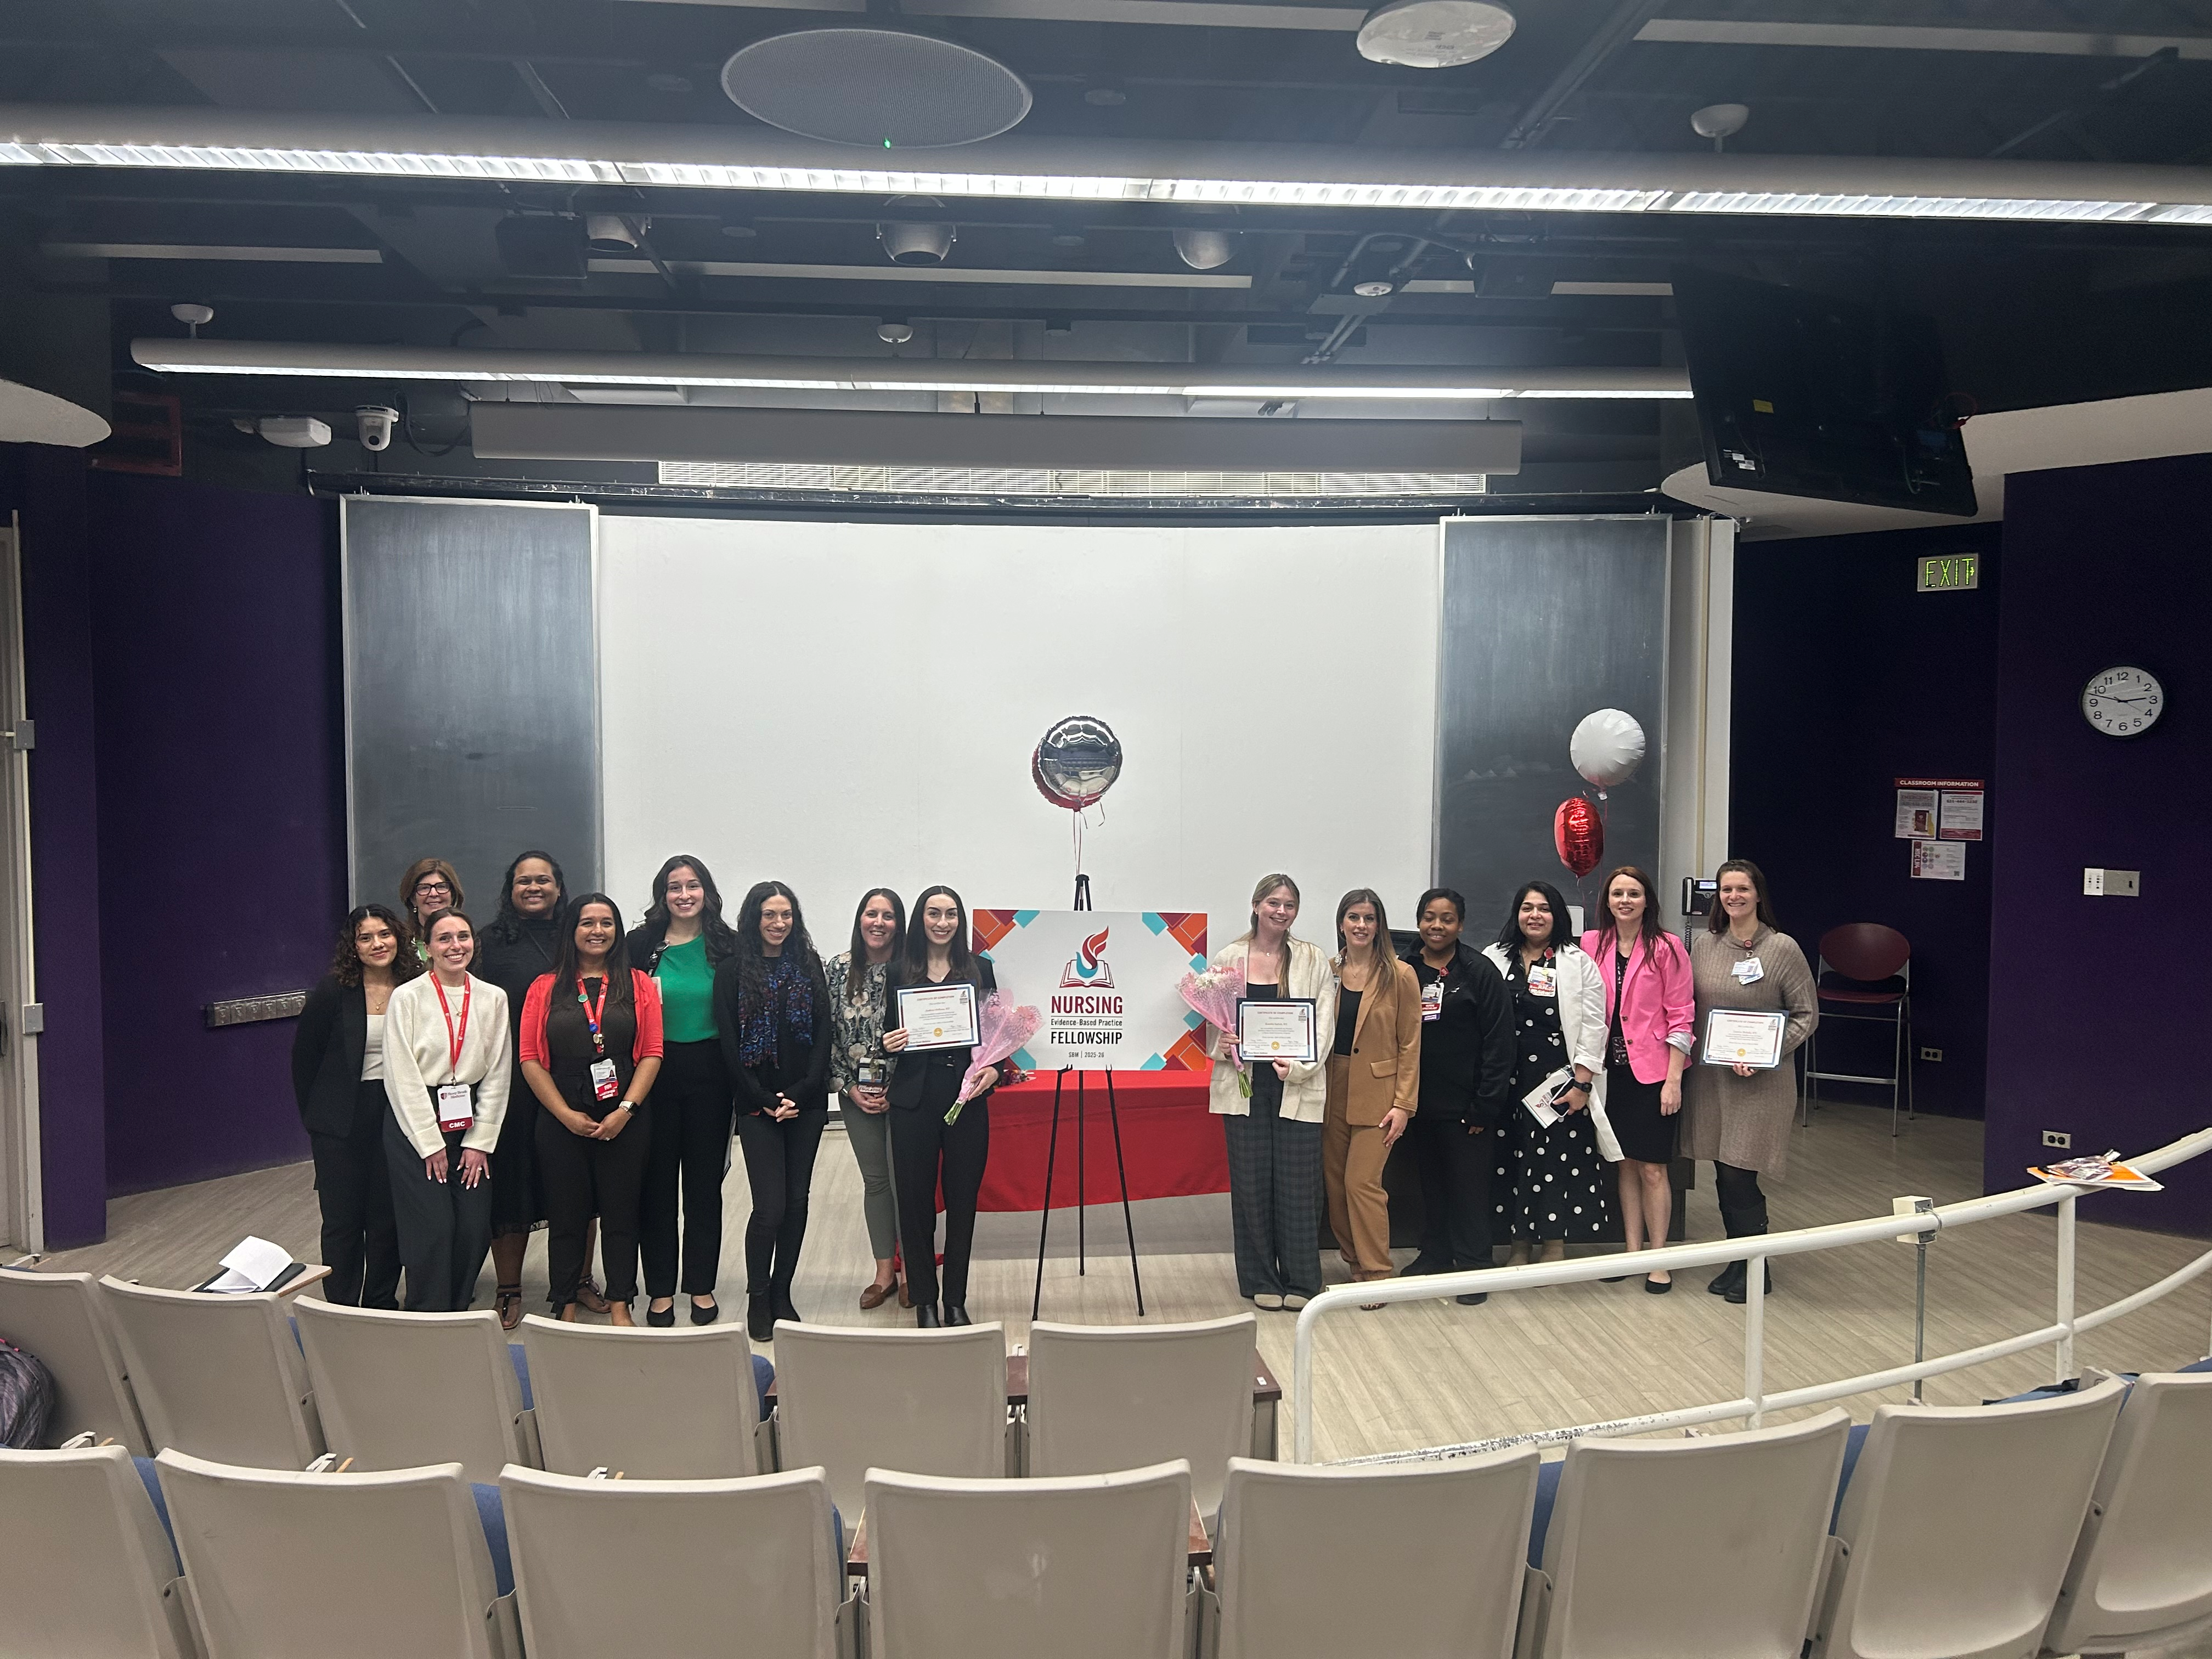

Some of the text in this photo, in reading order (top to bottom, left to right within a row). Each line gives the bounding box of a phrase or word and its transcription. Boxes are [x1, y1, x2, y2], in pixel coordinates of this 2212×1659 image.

[1926, 558, 1974, 587] EXIT
[2117, 672, 2129, 680] 12
[2136, 675, 2140, 683] 1
[2104, 676, 2112, 685] 11
[2094, 686, 2106, 694] 10
[2144, 683, 2152, 691] 2
[2089, 698, 2098, 707] 9
[2149, 696, 2158, 704] 3
[2094, 711, 2102, 719] 8
[2145, 709, 2153, 717] 4
[2119, 722, 2128, 731] 6
[2133, 718, 2142, 727] 5
[1051, 996, 1122, 1014] NURSING
[1051, 1031, 1122, 1045] FELLOWSHIP
